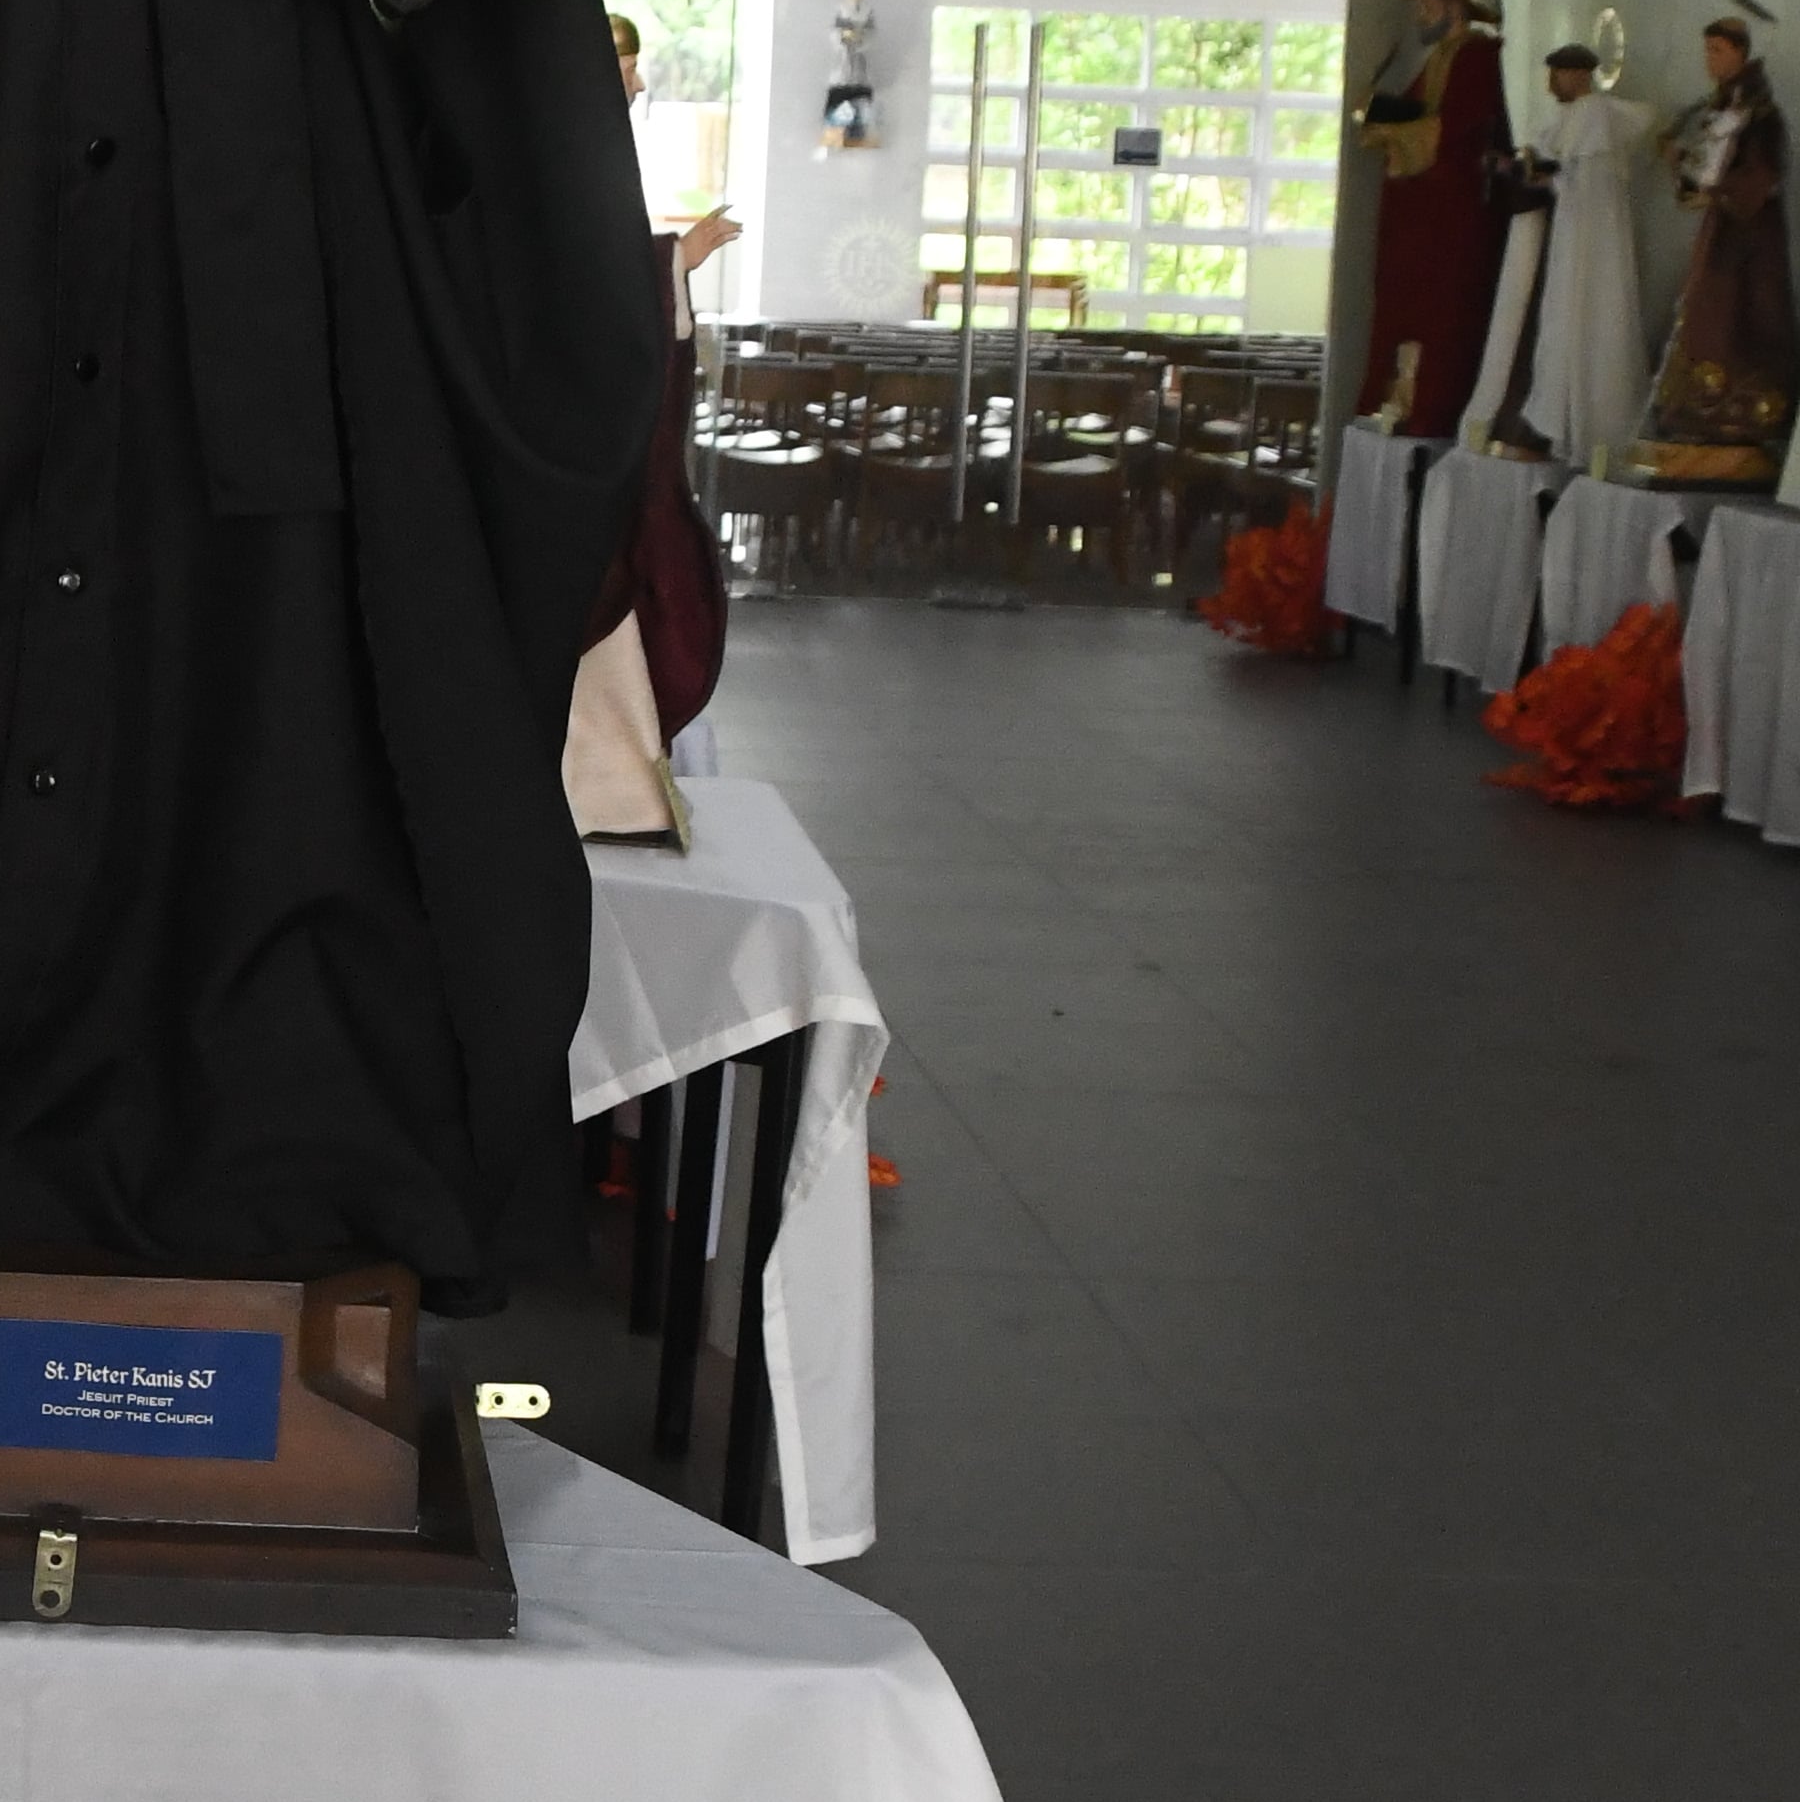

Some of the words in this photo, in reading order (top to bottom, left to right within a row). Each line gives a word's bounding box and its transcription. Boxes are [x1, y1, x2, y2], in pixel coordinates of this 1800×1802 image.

[44, 1360, 70, 1380] St.
[73, 1362, 129, 1385] Pieter
[132, 1366, 184, 1389] Kanis
[187, 1369, 217, 1389] SJ
[41, 1403, 102, 1418] DOCTOR
[154, 1411, 214, 1425] CHURCH
